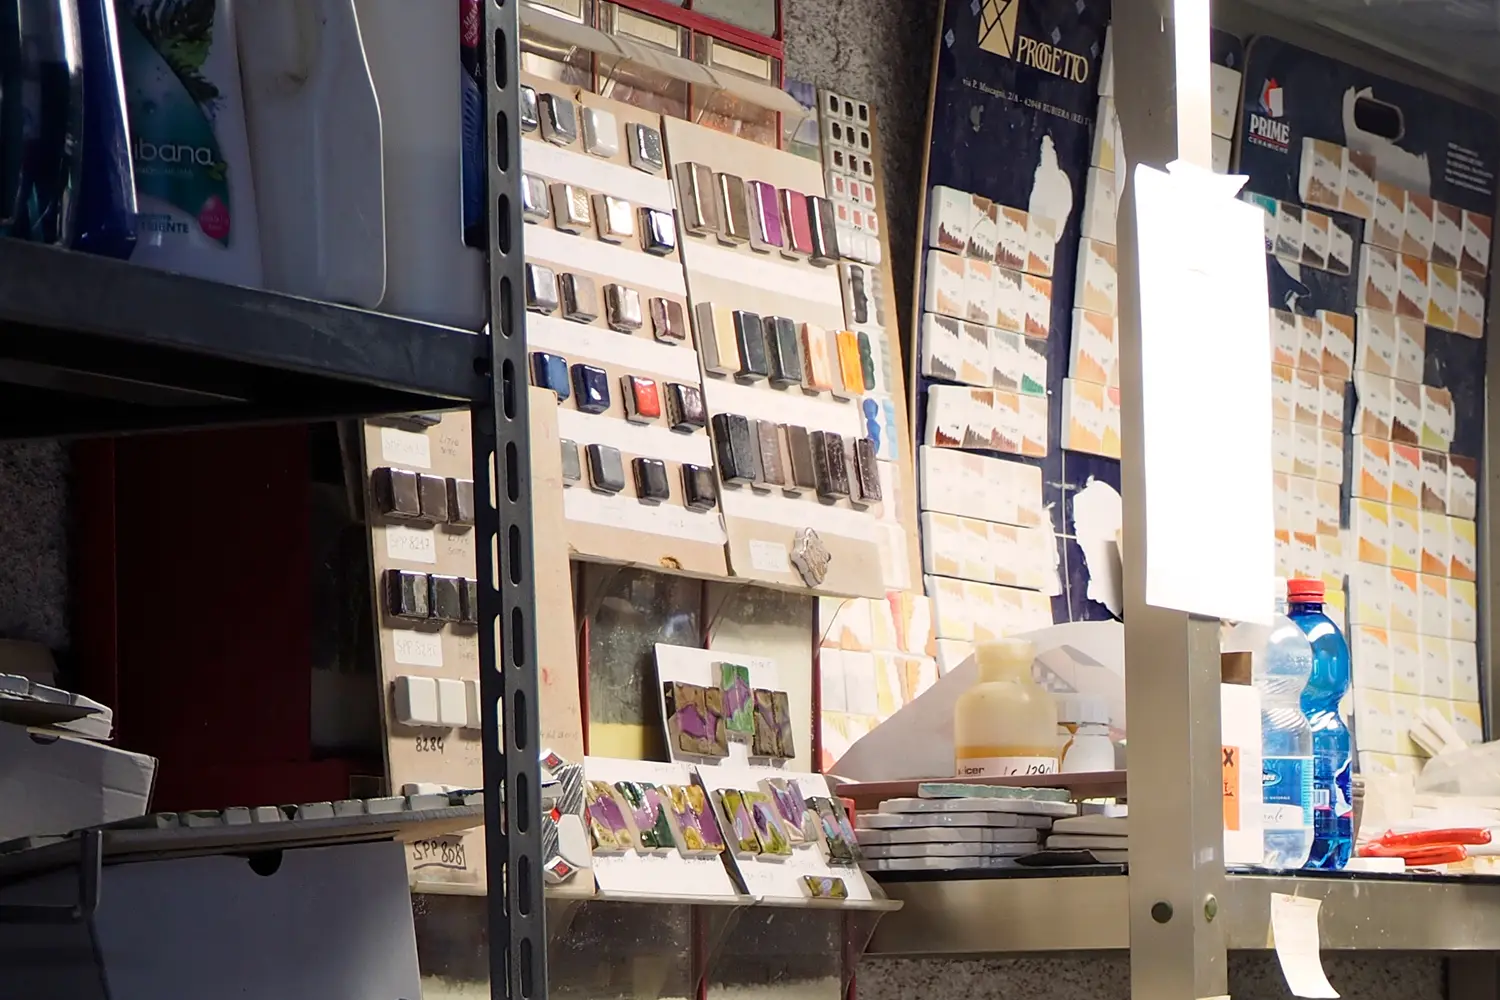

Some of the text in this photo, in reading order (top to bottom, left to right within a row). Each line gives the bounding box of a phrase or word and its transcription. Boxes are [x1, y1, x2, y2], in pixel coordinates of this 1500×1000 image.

[1016, 35, 1089, 83] PROGETTO
[1007, 92, 1018, 103] 2/A
[1042, 102, 1070, 120] RUBIERA
[1249, 113, 1291, 145] PRIME
[412, 840, 437, 860] SPP
